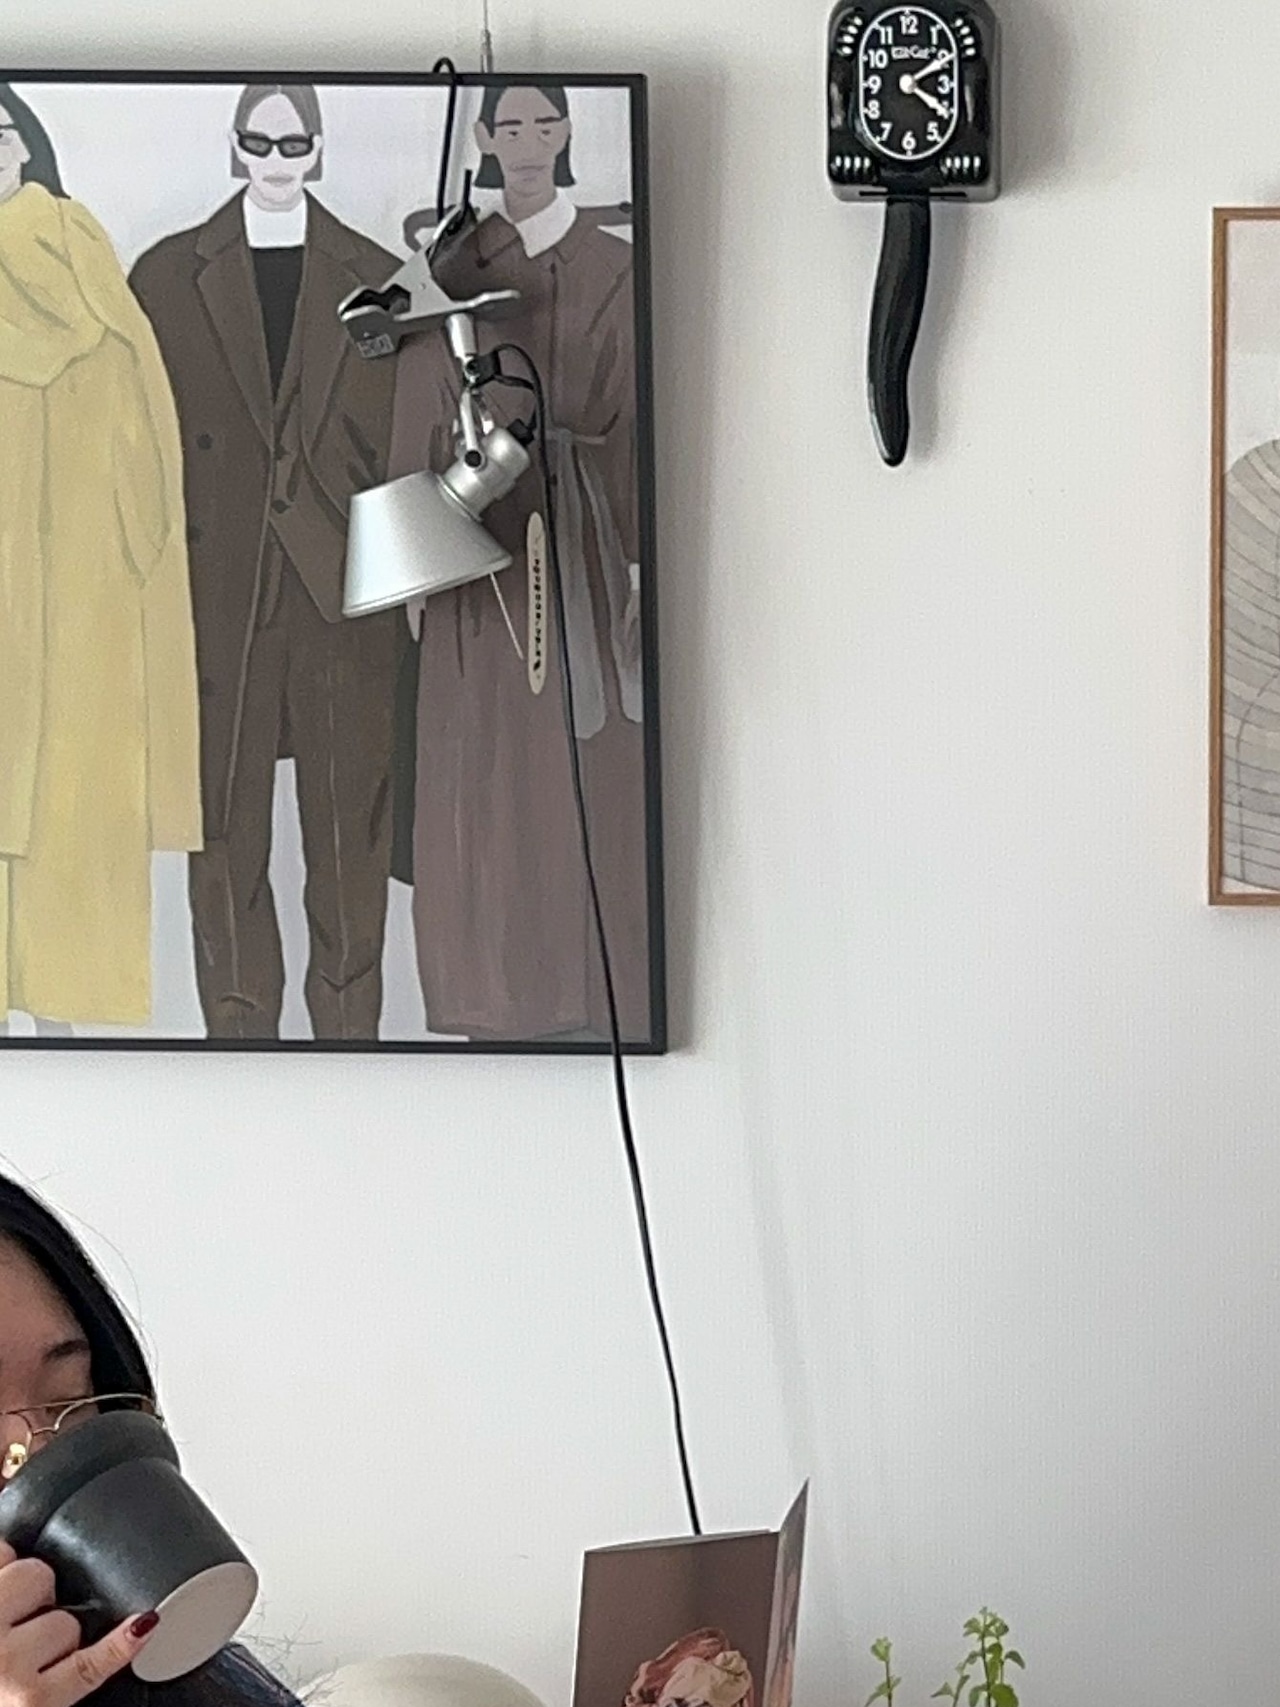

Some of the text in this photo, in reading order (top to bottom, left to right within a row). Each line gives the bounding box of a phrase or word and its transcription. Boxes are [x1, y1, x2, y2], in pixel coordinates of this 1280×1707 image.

[900, 15, 918, 34] 12
[879, 26, 893, 45] 11
[930, 27, 938, 44] 1
[868, 50, 888, 69] 10
[868, 75, 881, 94] 9
[938, 75, 950, 94] 3
[868, 100, 880, 119] 8
[880, 122, 892, 141] 7
[902, 132, 916, 150] 6
[926, 122, 939, 141] 5
